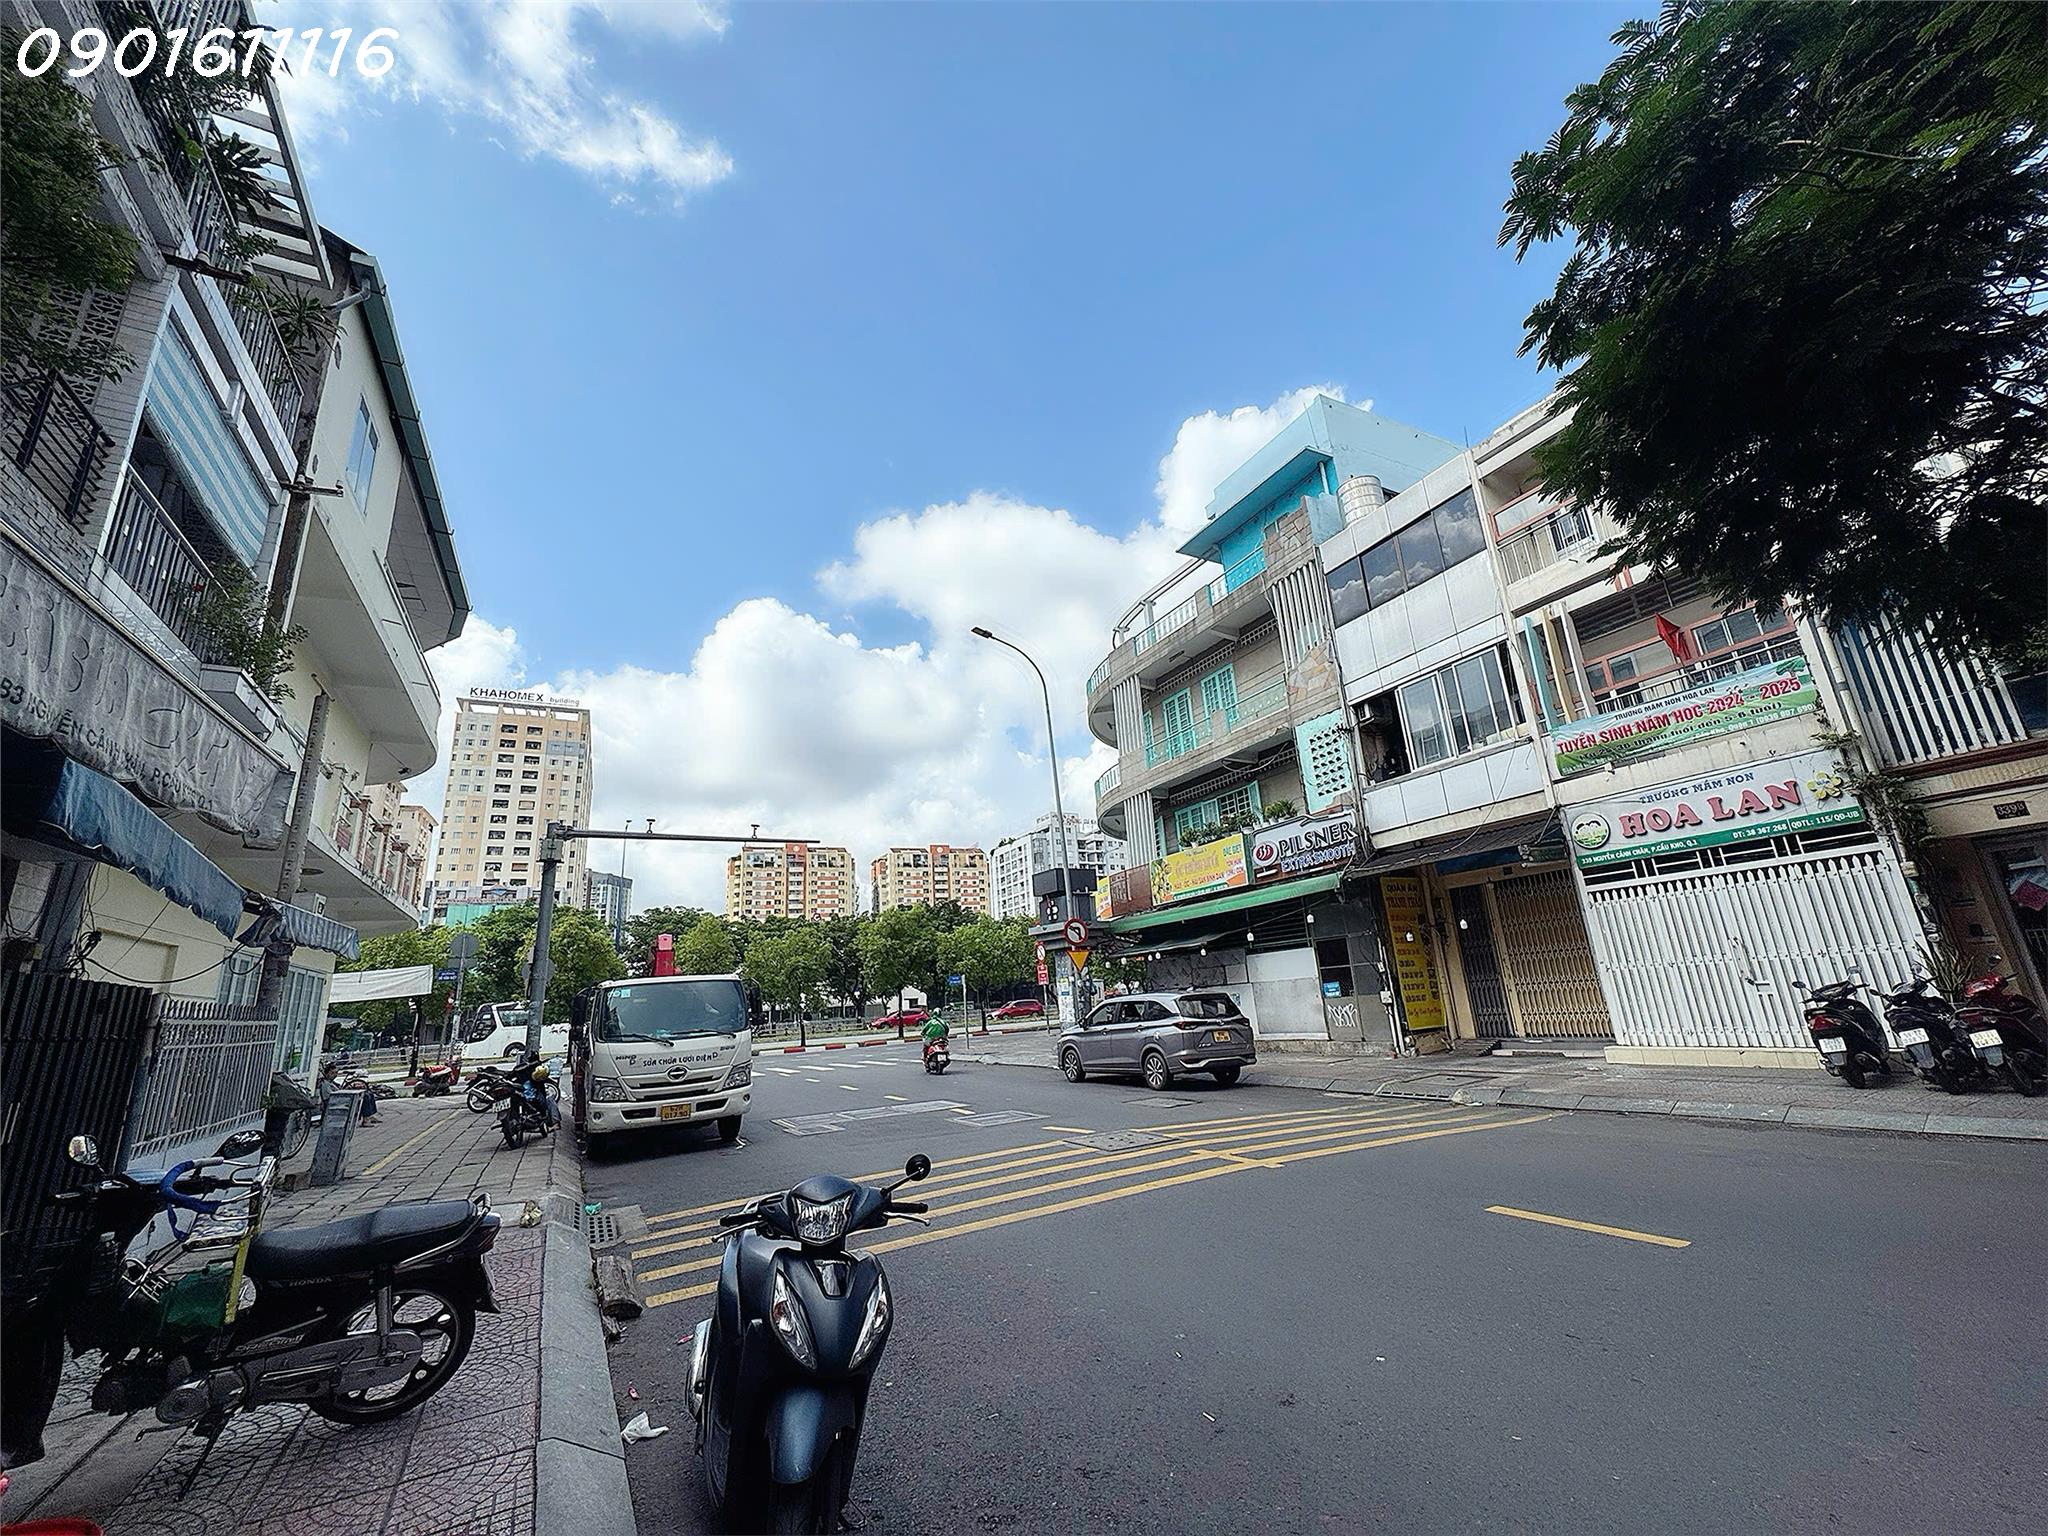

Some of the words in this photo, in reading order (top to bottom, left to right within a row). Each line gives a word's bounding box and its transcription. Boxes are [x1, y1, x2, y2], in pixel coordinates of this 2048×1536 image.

[470, 687, 544, 702] KHAHOMEX
[549, 697, 580, 707] building
[1664, 696, 1682, 707] NON
[1682, 691, 1698, 702] HOA
[1699, 686, 1715, 697] LAN
[1556, 731, 1598, 755] TUYỂN
[1600, 722, 1635, 744] SINH
[1633, 715, 1671, 734] NĂM
[1673, 704, 1704, 725] HỌC
[1707, 692, 1745, 715] 2024
[1759, 676, 1801, 701] 2025
[1726, 772, 1755, 786] NON
[1618, 803, 1703, 839] HOA
[1706, 779, 1802, 820] LAN
[1278, 820, 1356, 857] PILSNER
[1280, 854, 1314, 873] EXTRA
[1313, 842, 1354, 865] SMOOTH
[289, 1276, 333, 1287] HONDA
